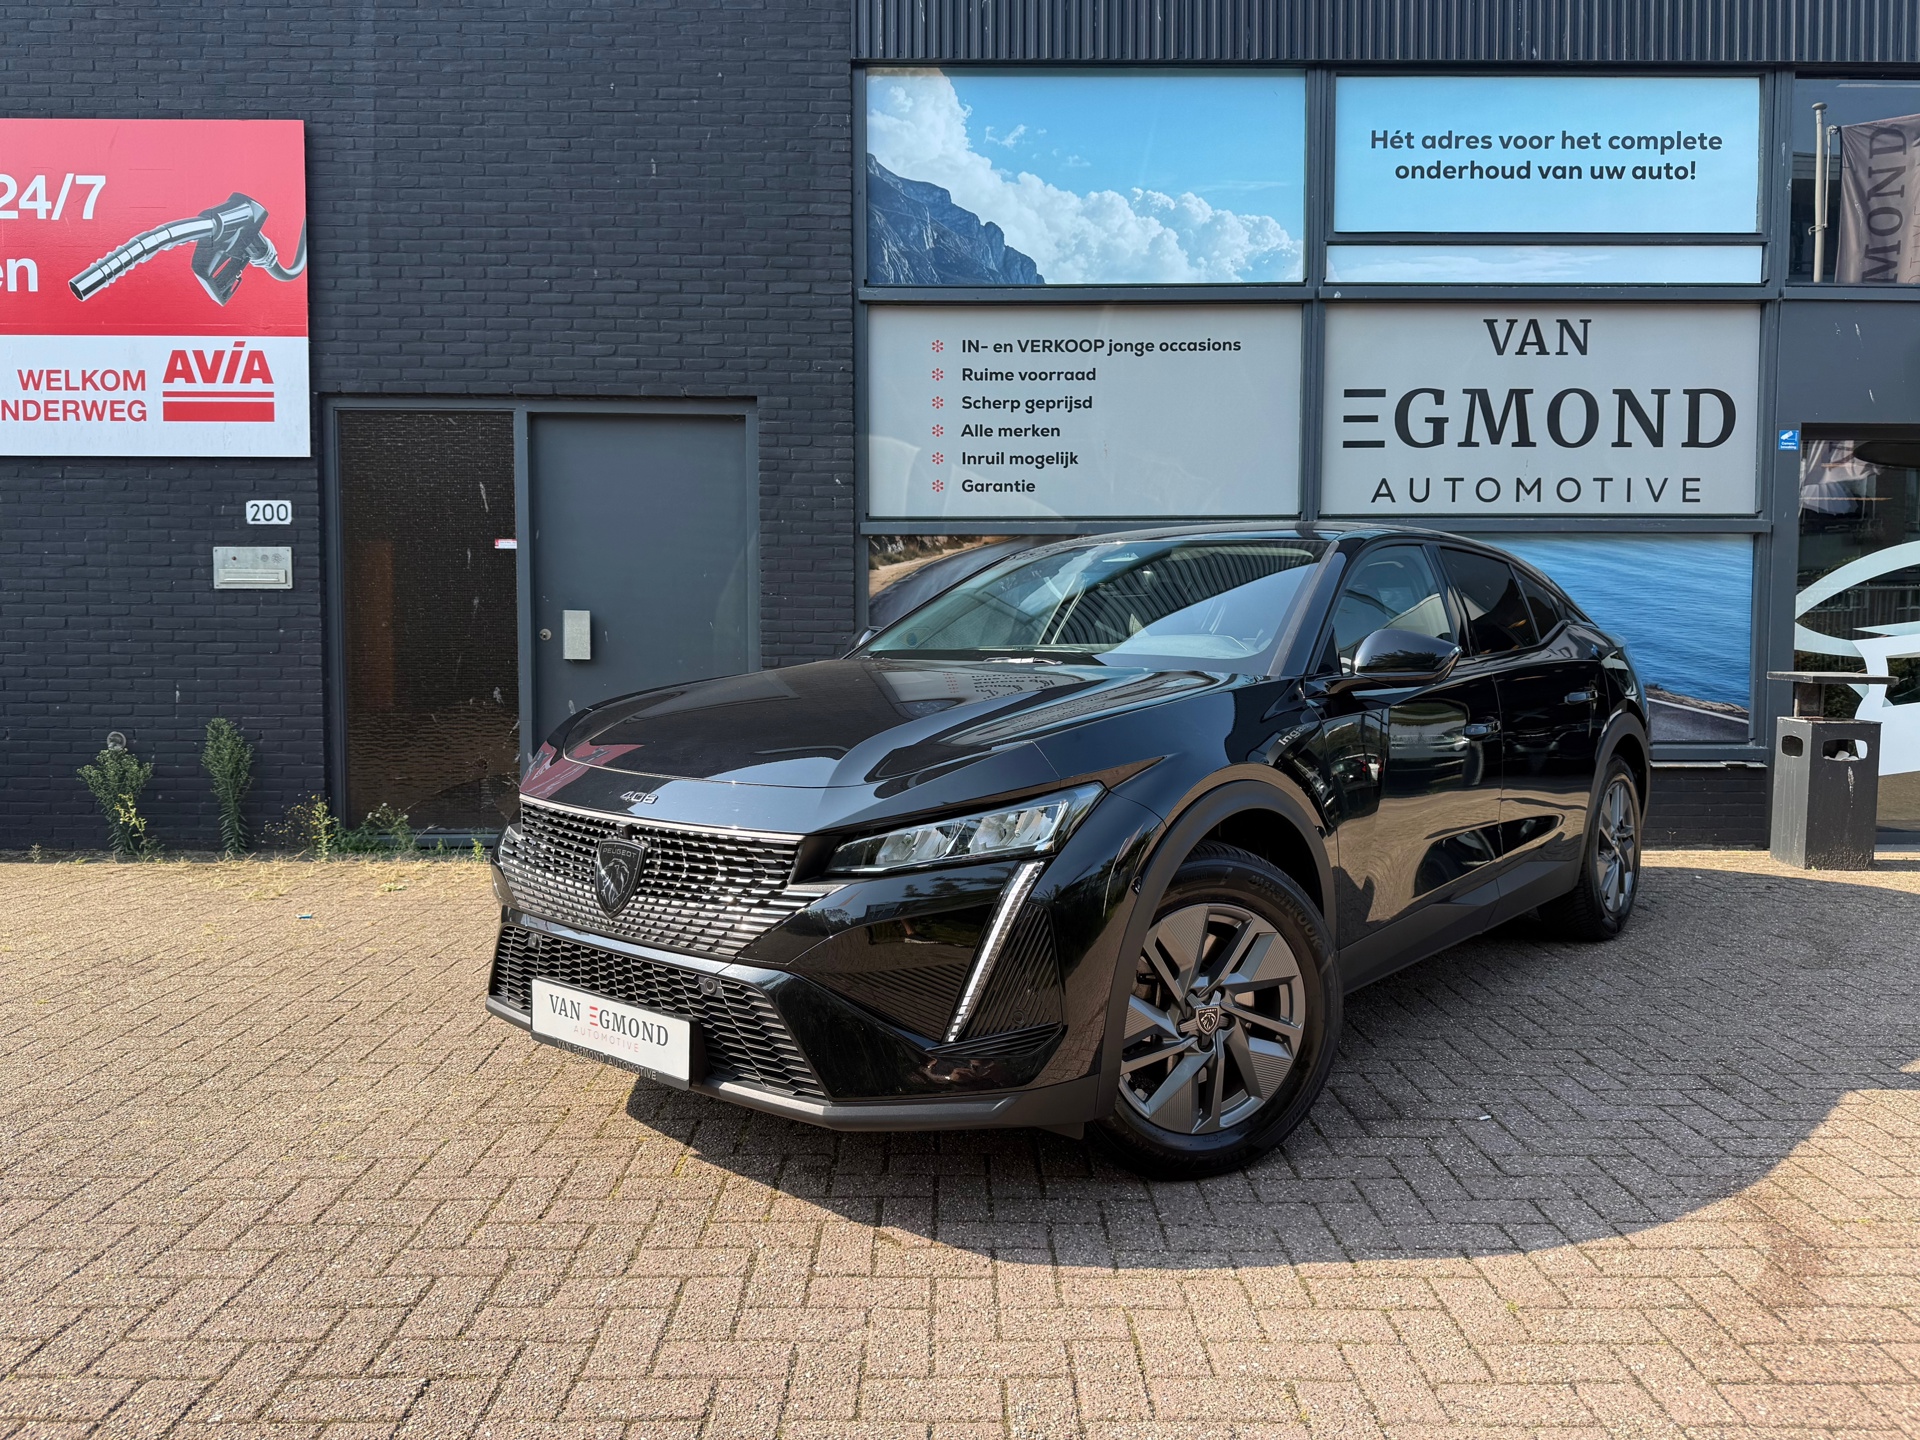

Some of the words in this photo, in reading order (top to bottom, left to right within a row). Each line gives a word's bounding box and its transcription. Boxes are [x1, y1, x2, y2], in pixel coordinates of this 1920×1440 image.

[1370, 129, 1415, 150] Hét
[1421, 129, 1493, 150] adres
[1498, 135, 1556, 150] voor
[1561, 129, 1602, 150] het
[1607, 130, 1723, 156] complete
[1394, 159, 1532, 180] onderhoud
[1537, 165, 1583, 180] van
[1589, 165, 1627, 180] uw
[1631, 160, 1696, 181] auto!
[0, 172, 107, 221] 24/7
[962, 339, 989, 353] IN-
[992, 342, 1014, 354] en
[1016, 338, 1105, 353] VERKOOP
[1106, 338, 1155, 358] jonge
[1158, 337, 1242, 352] occasions
[1482, 318, 1593, 356] VAN
[17, 369, 147, 391] WELKOM
[962, 367, 1015, 382] Ruime
[1017, 367, 1097, 382] voorraad
[961, 395, 1021, 413] Scherp
[1024, 395, 1093, 415] geprijsd
[1342, 387, 1737, 449] EGMOND
[960, 423, 994, 438] Alle
[998, 423, 1061, 438] merken
[962, 451, 1005, 466] Inruil
[1009, 451, 1079, 470] mogelijk
[961, 478, 1036, 493] Garantie
[1370, 476, 1701, 504] AUTOMOTIVE
[249, 503, 289, 522] 200
[619, 790, 659, 805] 408
[602, 847, 637, 859] PEUGEOT
[549, 993, 581, 1021] VAN
[589, 1005, 669, 1047] EGMOND
[573, 1025, 640, 1053] AUTOMOTIVE
[557, 1040, 571, 1050] VAN
[608, 1057, 657, 1080] AUTOMOTIVE
